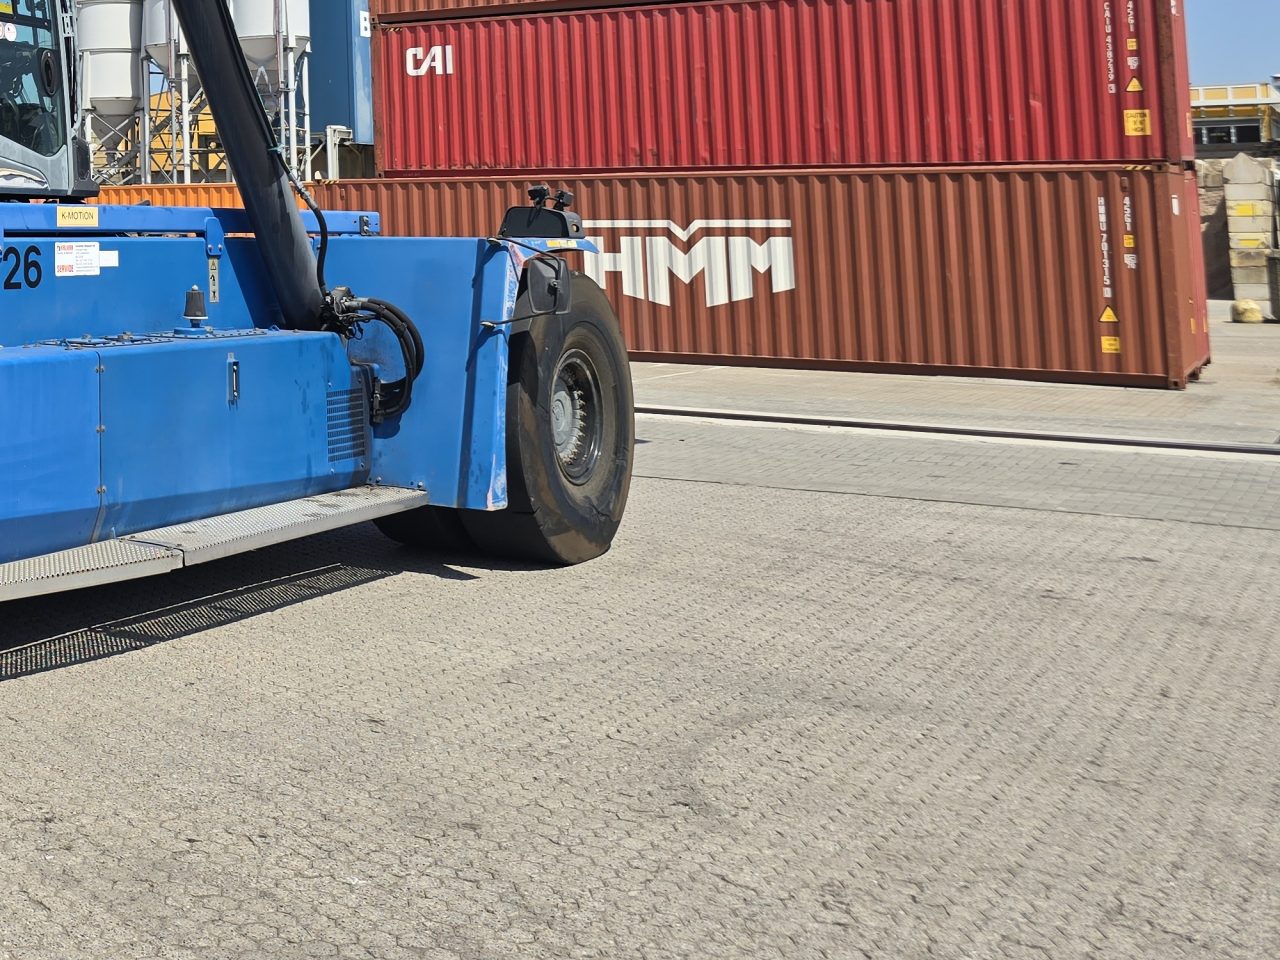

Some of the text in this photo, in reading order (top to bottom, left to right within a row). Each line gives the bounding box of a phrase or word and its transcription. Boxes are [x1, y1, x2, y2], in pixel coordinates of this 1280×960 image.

[405, 45, 454, 76] CAI
[61, 211, 94, 220] K-MOTION
[1123, 196, 1132, 231] 45G1
[3, 245, 42, 290] 26
[583, 235, 795, 308] HMM
[1100, 234, 1111, 285] 701315
